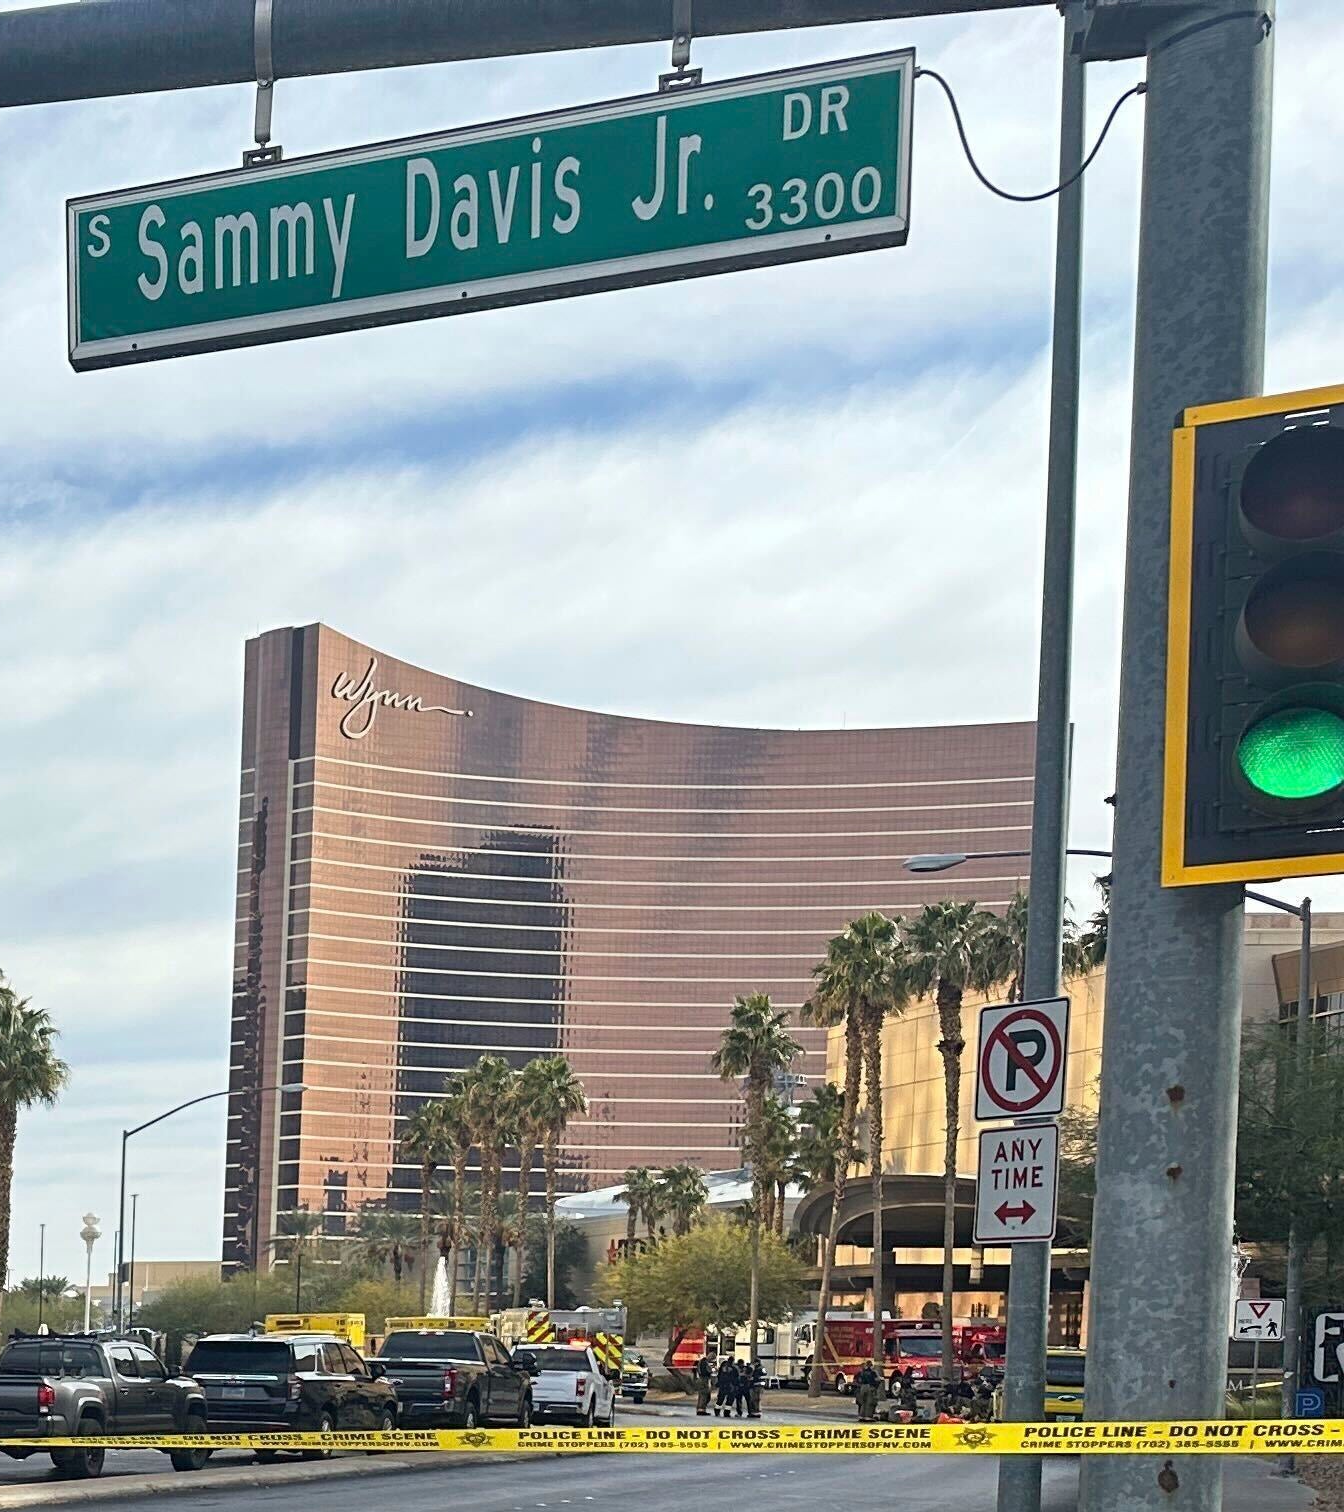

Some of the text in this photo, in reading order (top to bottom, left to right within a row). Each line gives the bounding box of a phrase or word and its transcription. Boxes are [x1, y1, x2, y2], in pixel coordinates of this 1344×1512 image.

[783, 86, 850, 142] DR
[87, 115, 714, 301] S Sammy Davis Jr.
[744, 166, 883, 233] 3300
[994, 1139, 1041, 1164] ANY
[991, 1166, 1044, 1191] TIME
[320, 1432, 375, 1440] CRIME
[381, 1431, 436, 1440] SCENE
[518, 1428, 931, 1440] POLICE LINE DO NOT CROSS CRIME SCENE
[1021, 1440, 1062, 1448] CRIME
[1066, 1440, 1132, 1448] STOPPERS
[1265, 1439, 1344, 1448] WWW.CRIM
[1024, 1424, 1324, 1438] POLICE LINE DO NOT CROSS
